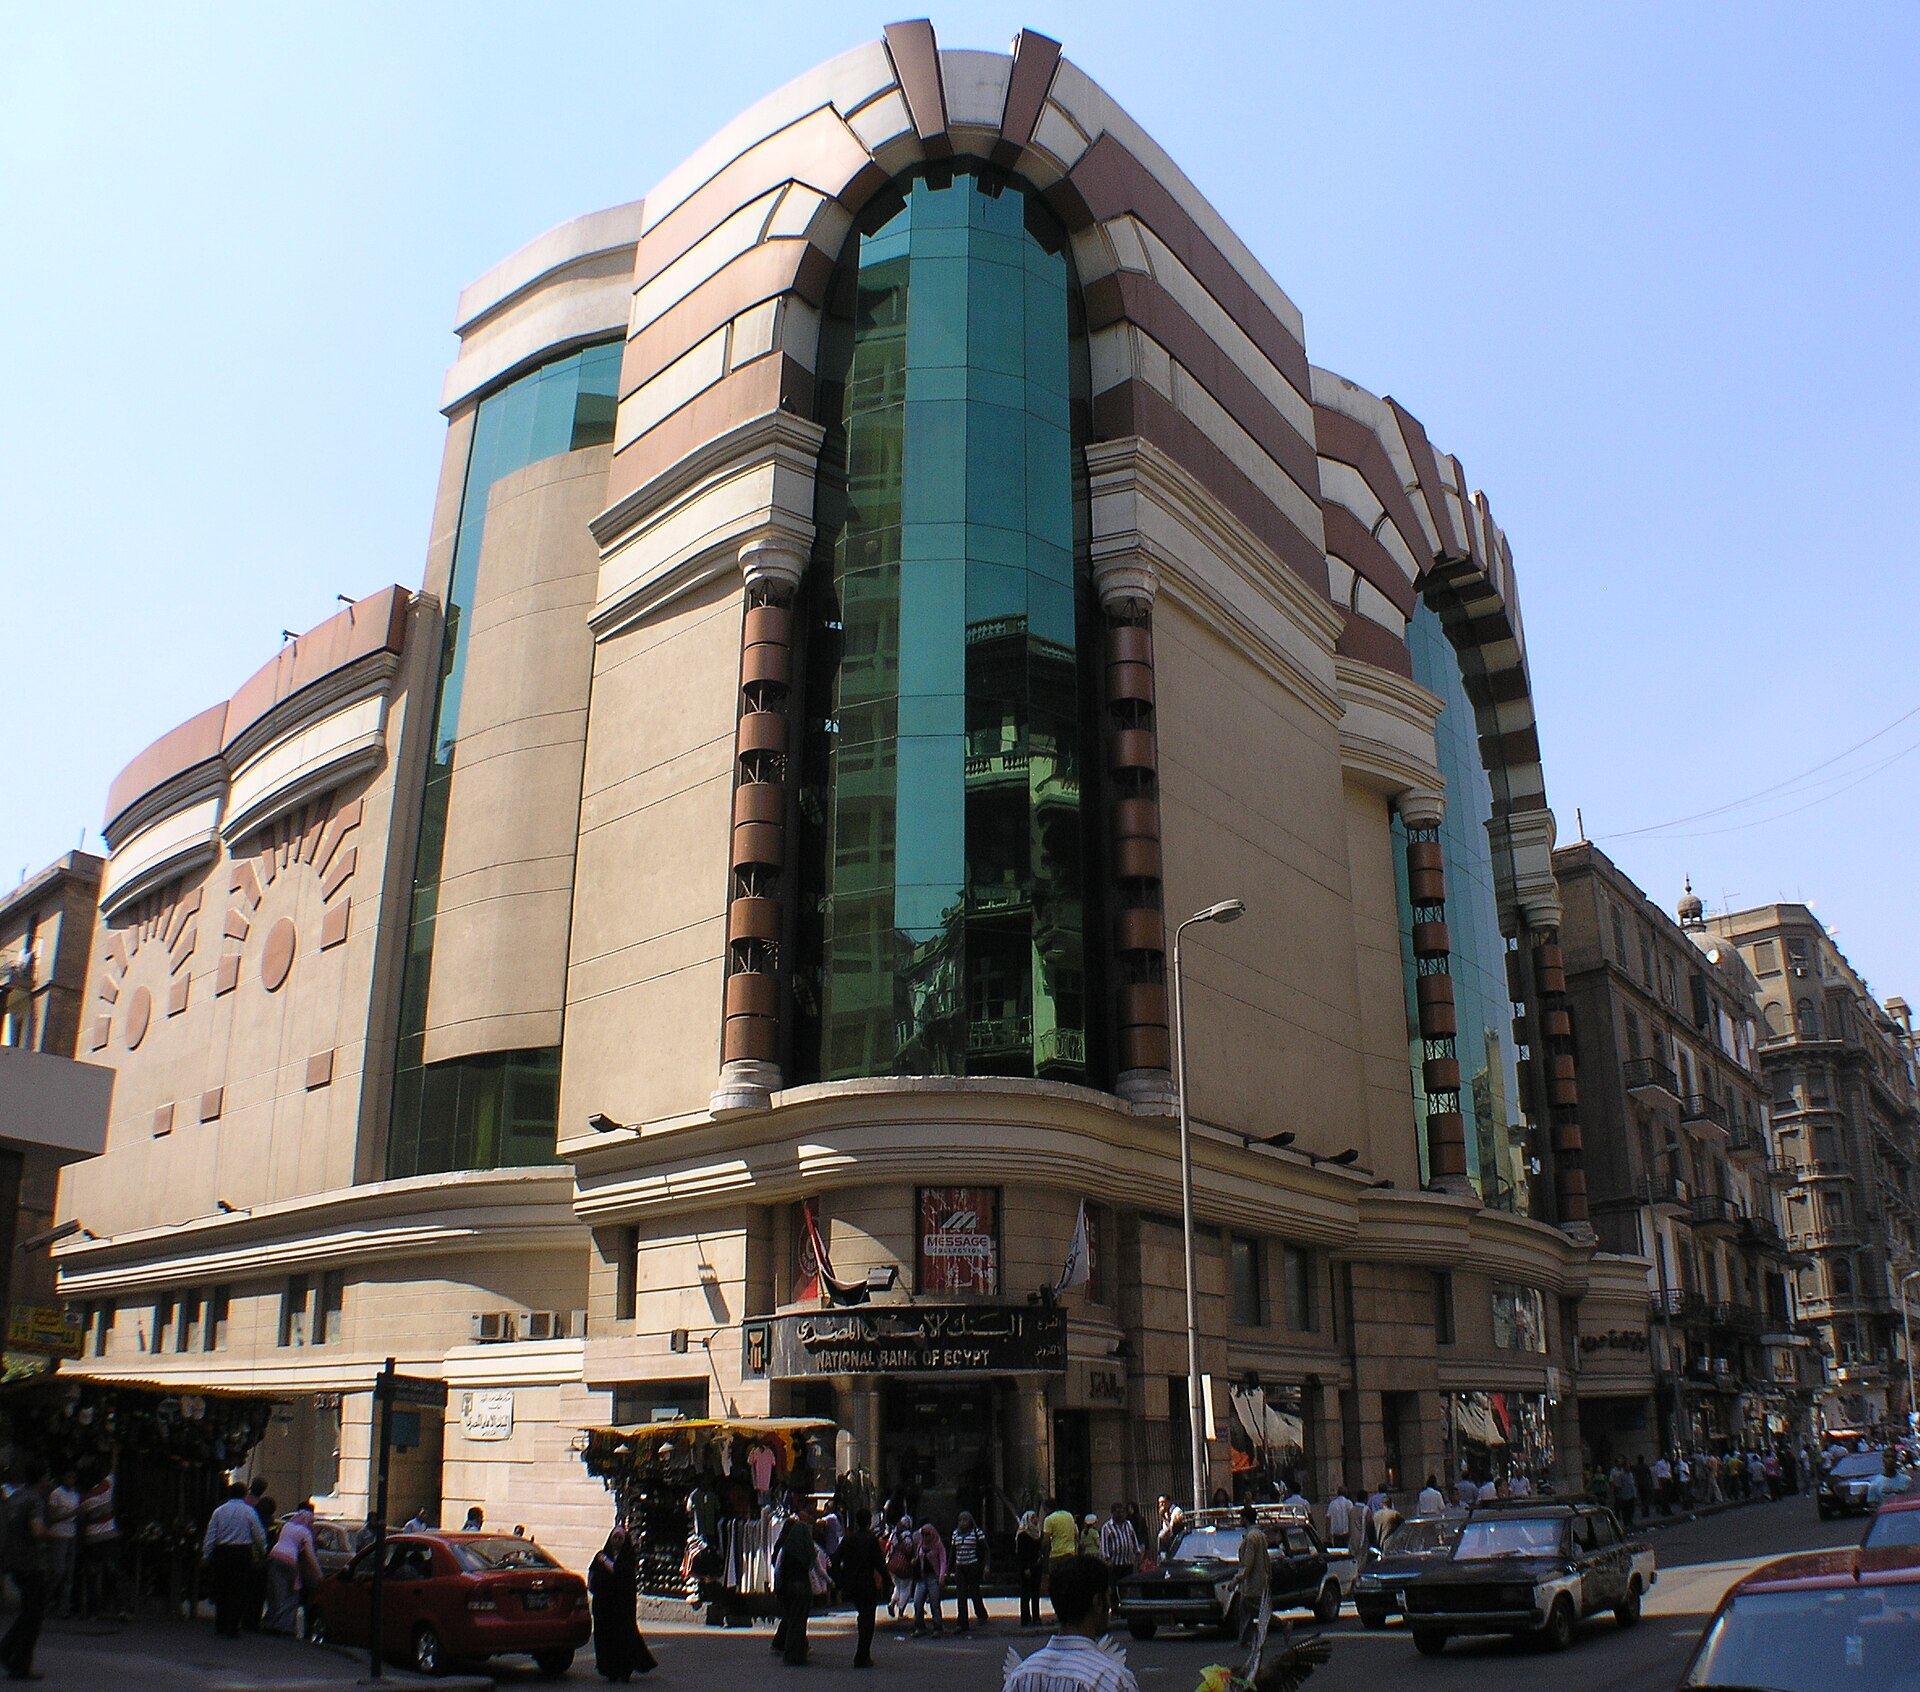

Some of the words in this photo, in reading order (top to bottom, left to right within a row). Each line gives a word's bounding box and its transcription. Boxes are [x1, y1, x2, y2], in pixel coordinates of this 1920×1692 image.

[927, 1236, 987, 1247] MESSAGE
[816, 1350, 875, 1371] NATIONAL
[879, 1349, 917, 1368] BANK
[922, 1349, 940, 1367] OF
[943, 1349, 990, 1367] EGYPT
